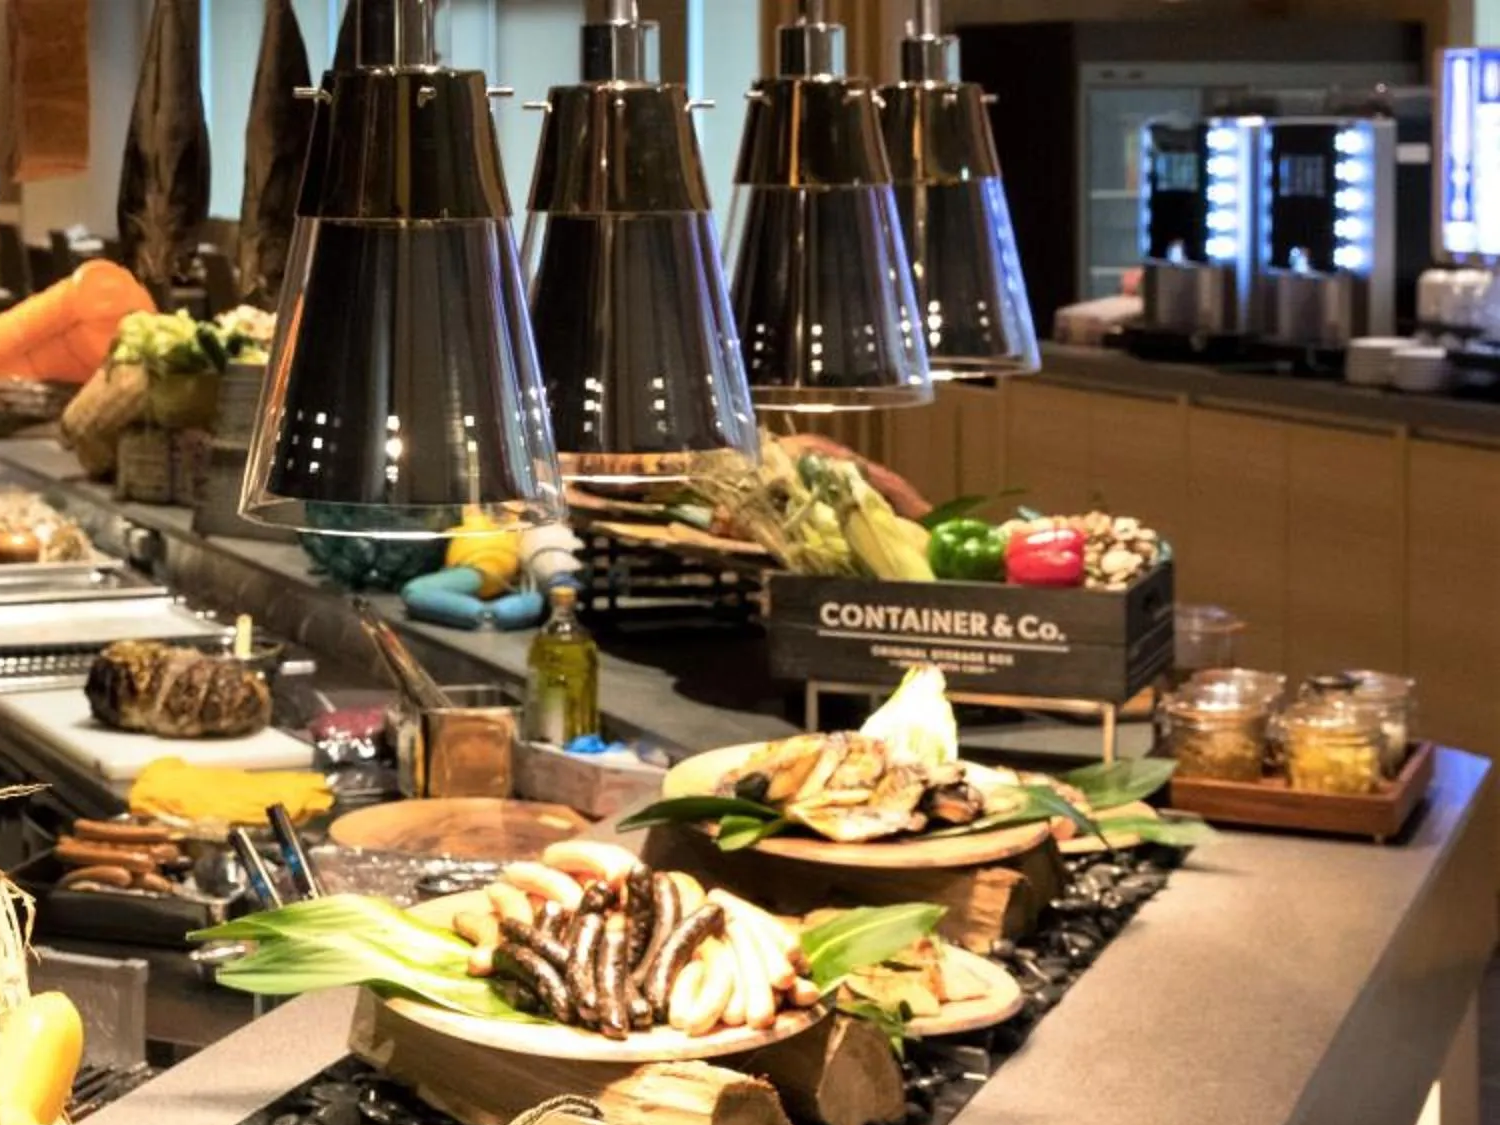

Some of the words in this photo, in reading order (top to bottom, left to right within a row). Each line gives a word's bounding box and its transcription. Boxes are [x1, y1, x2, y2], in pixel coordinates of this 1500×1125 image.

[819, 601, 989, 638] CONTAINER
[991, 612, 1014, 639] &
[1016, 614, 1067, 643] Co.
